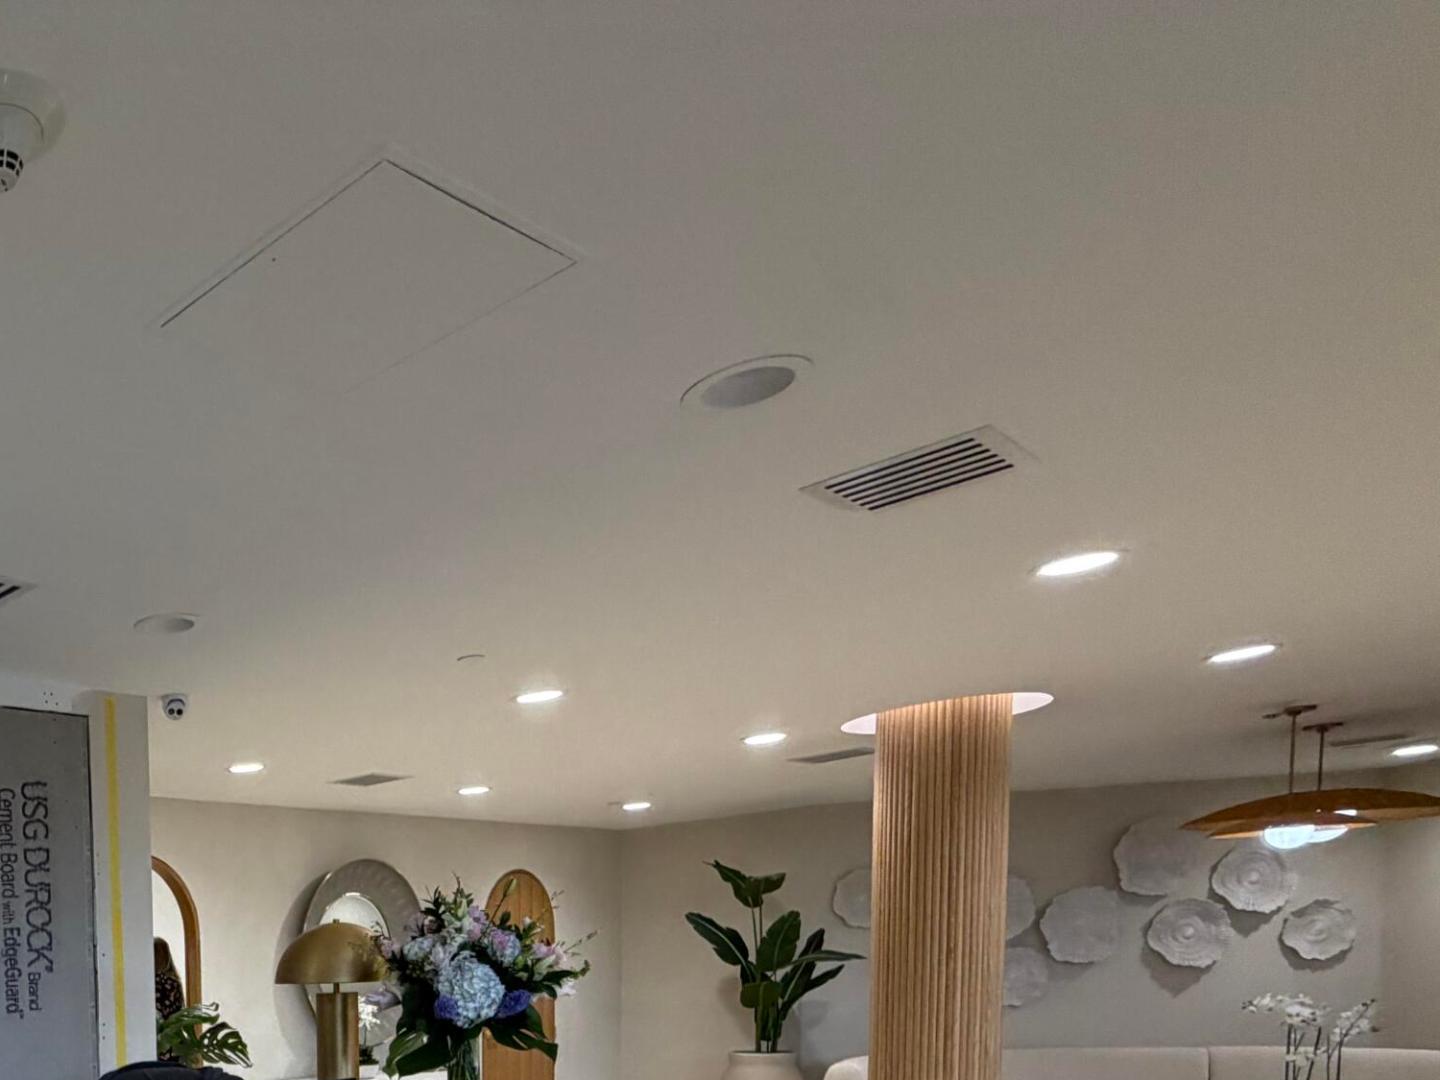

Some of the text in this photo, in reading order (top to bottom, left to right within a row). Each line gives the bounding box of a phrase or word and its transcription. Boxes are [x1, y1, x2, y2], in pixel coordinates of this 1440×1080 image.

[21, 781, 49, 840] USG
[0, 853, 19, 898] Board
[1, 901, 13, 925] with
[28, 972, 42, 1011] Brand
